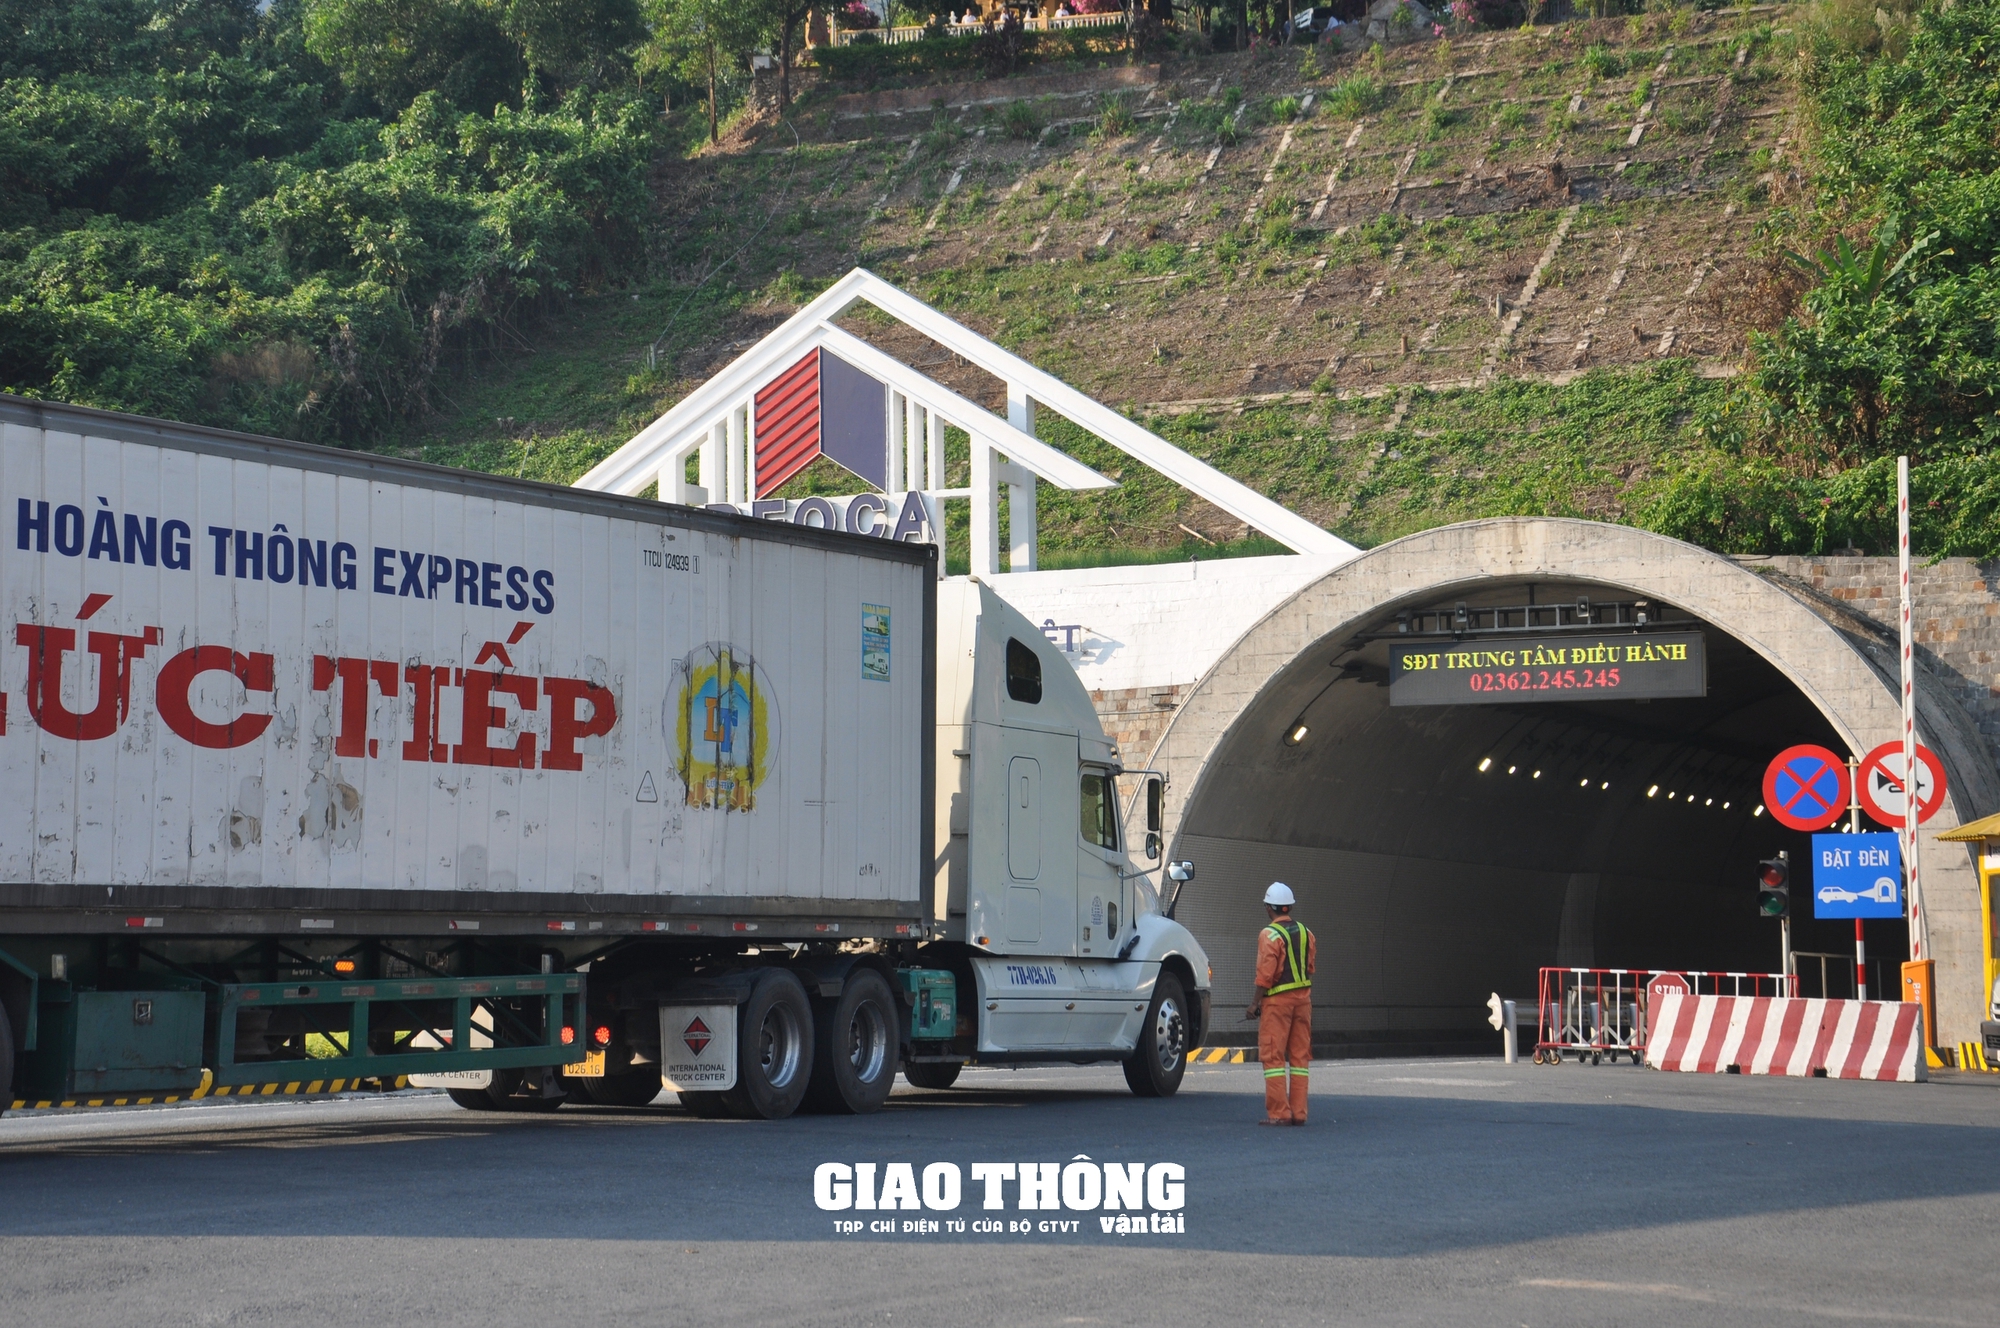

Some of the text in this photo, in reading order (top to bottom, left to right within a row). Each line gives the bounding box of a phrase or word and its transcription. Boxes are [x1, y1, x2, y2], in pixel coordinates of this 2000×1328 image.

[16, 495, 555, 615] HOÀNG THÔNG EXPRESS
[643, 549, 662, 568] TTCU
[664, 552, 690, 572] 124939
[1403, 641, 1687, 671] SĐT TRUNG TÂM ĐIỀU HÀNH
[0, 593, 617, 771] ỨC TIẾP
[1469, 668, 1621, 692] 02362.245.245
[1823, 846, 1890, 870] BẬT ĐÈN
[1007, 965, 1057, 985] 77H-026.16
[669, 1064, 726, 1072] INTERNATIONAL
[670, 1073, 726, 1082] TRUCK CENTER
